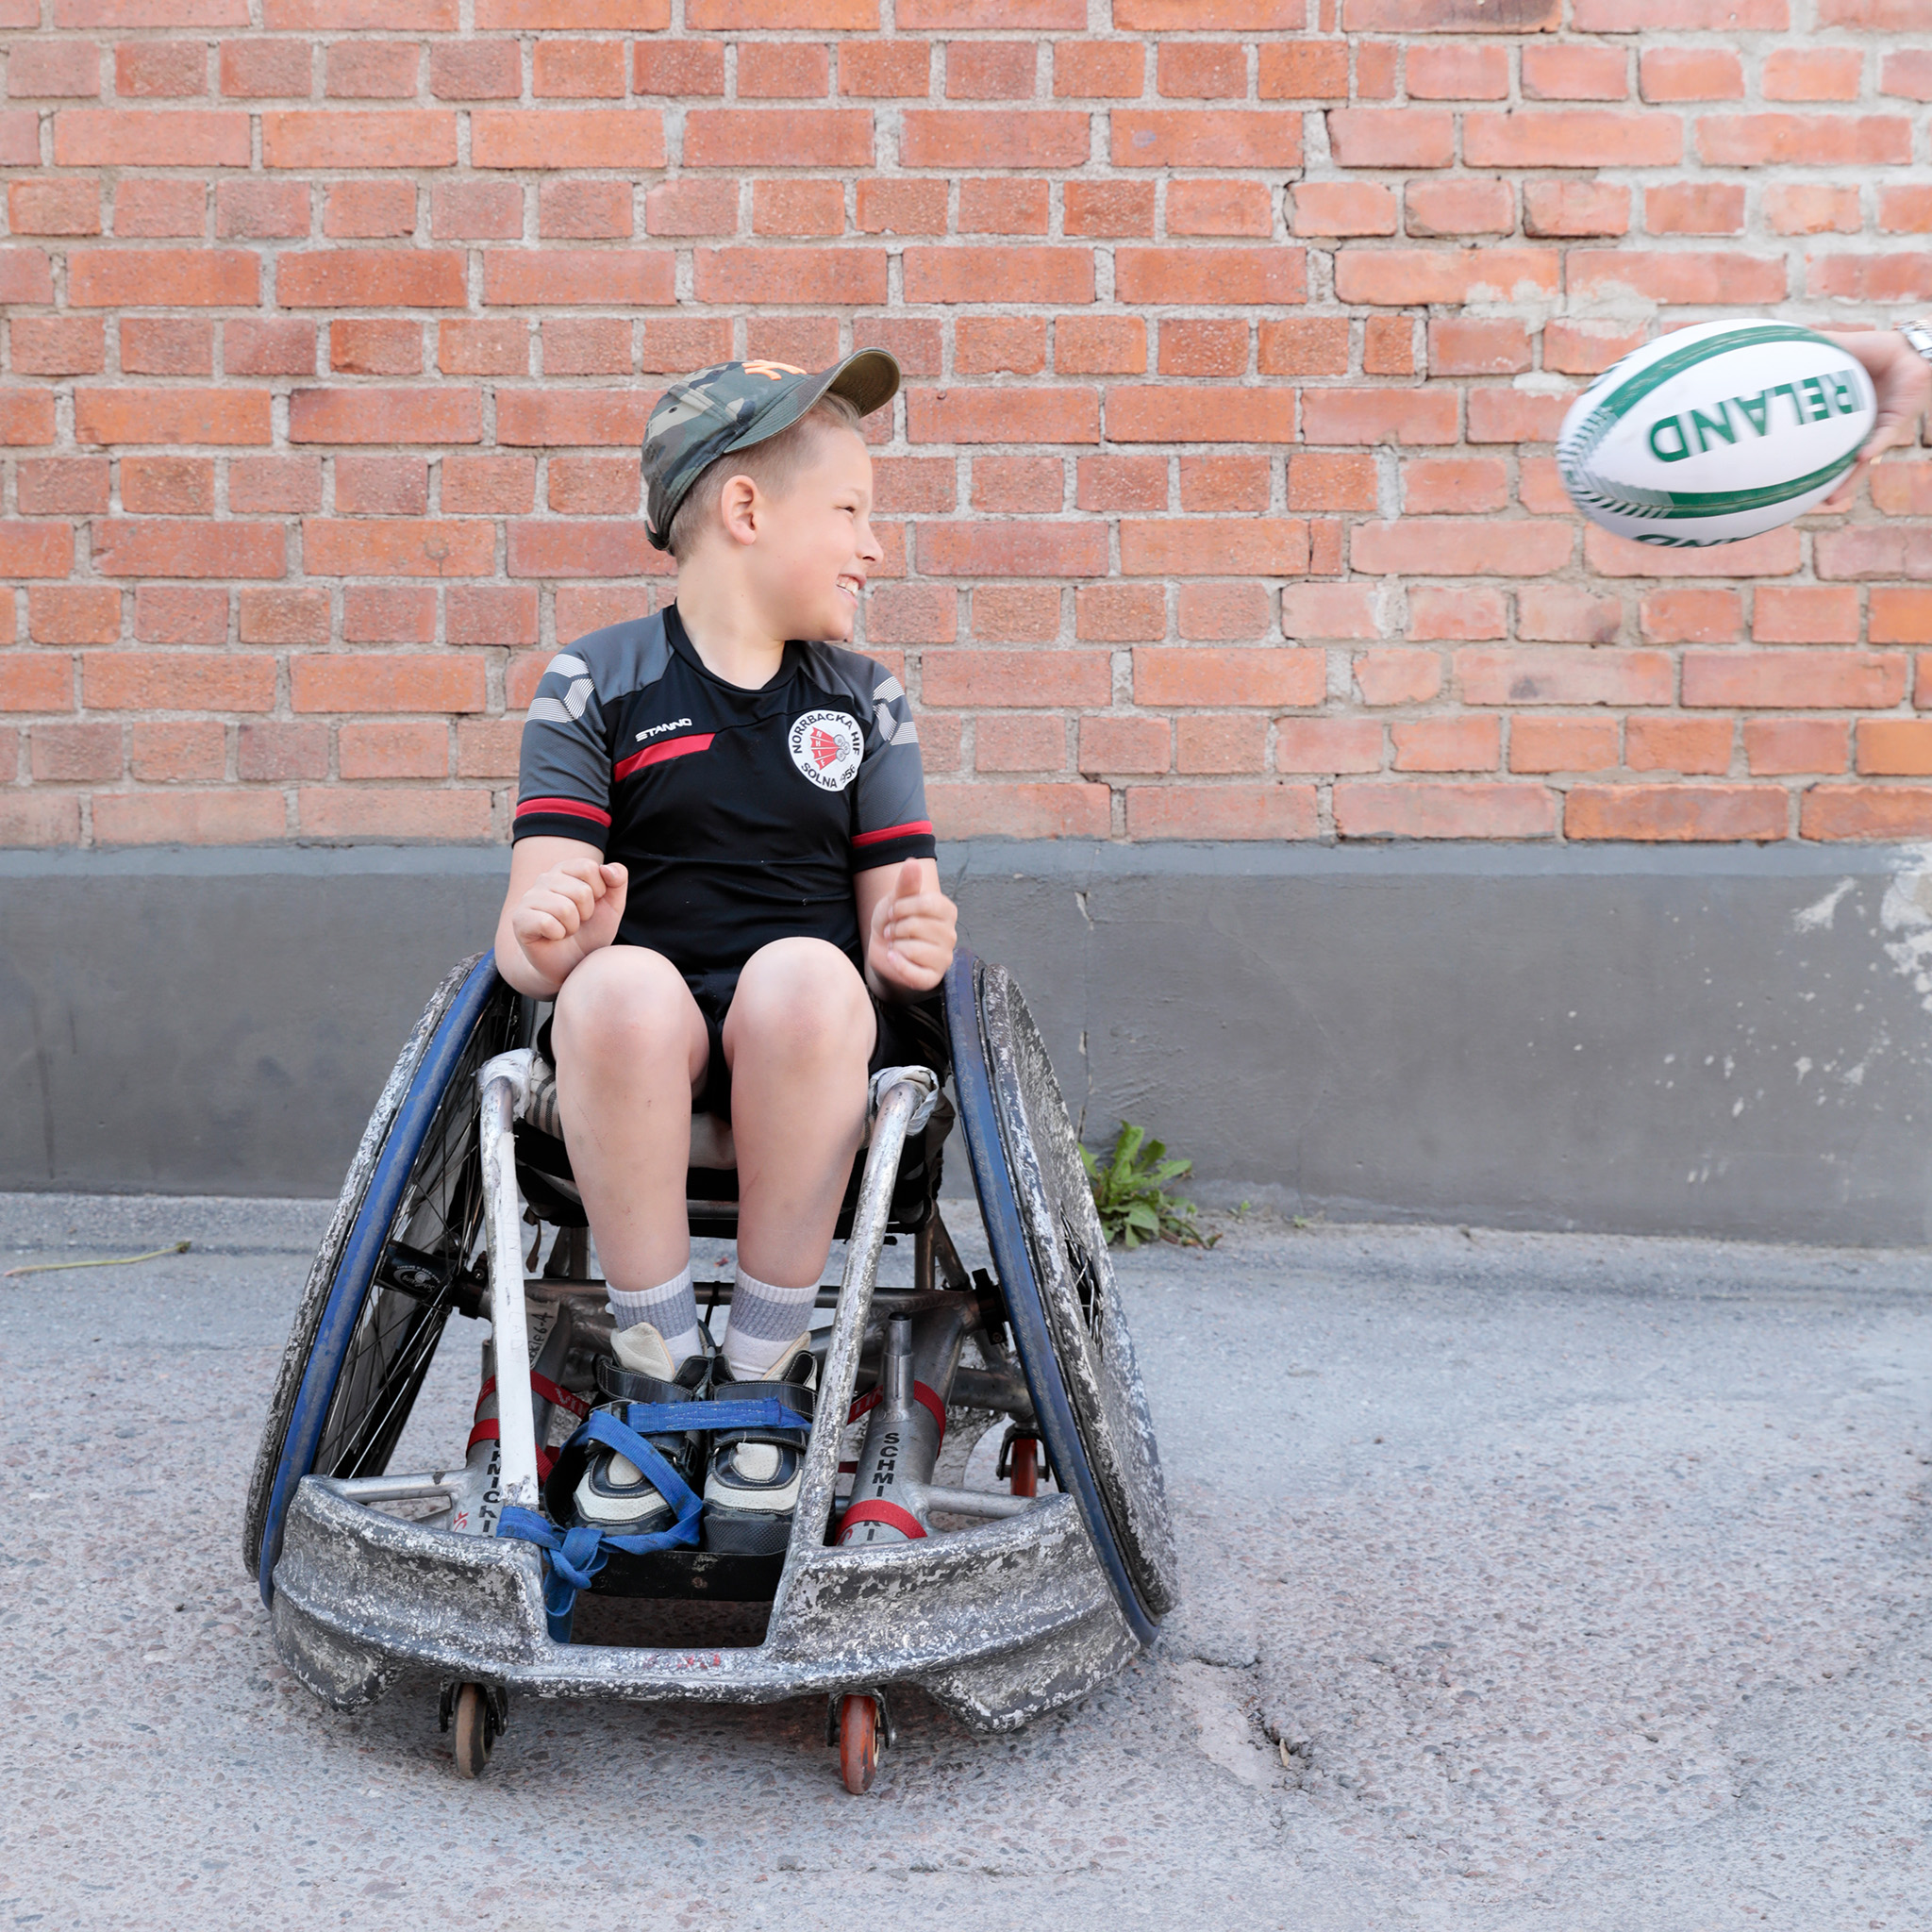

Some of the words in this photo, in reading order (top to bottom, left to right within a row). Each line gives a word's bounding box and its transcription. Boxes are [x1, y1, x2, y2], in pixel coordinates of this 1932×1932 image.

[635, 718, 693, 741] STANNO
[791, 713, 853, 755] NORRBACKA
[851, 731, 860, 756] HIF
[801, 762, 838, 789] SOLNA
